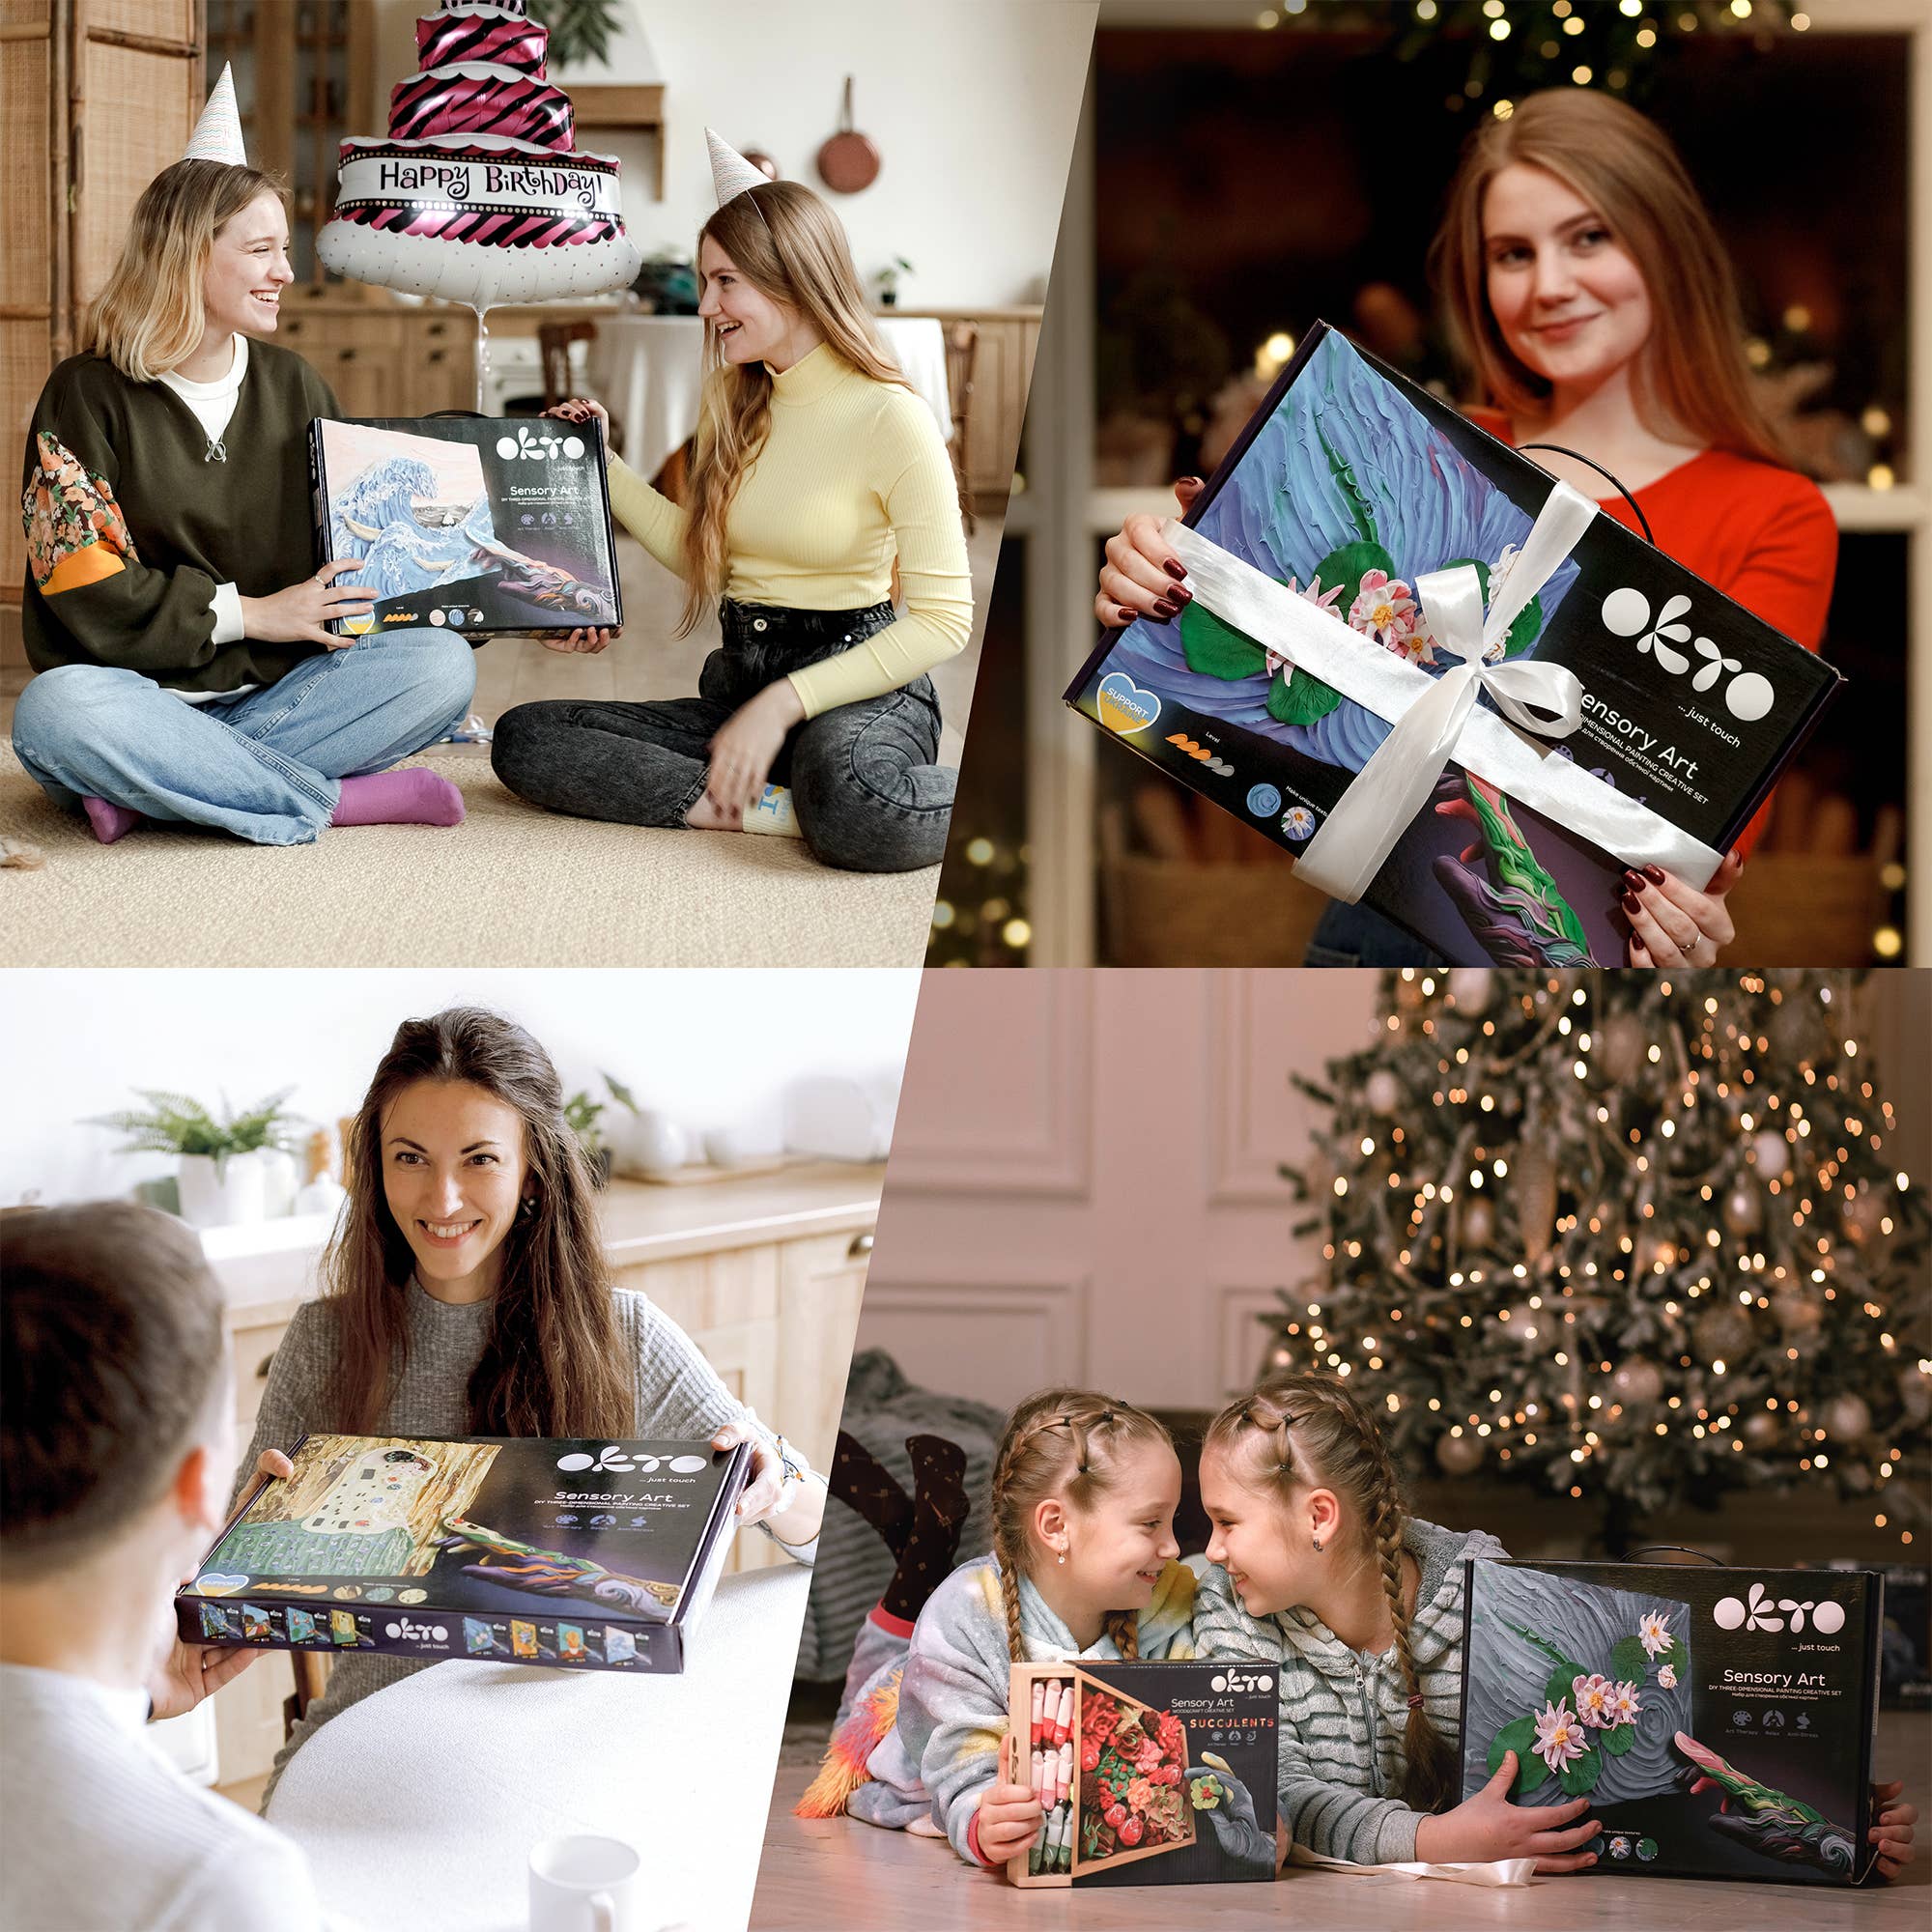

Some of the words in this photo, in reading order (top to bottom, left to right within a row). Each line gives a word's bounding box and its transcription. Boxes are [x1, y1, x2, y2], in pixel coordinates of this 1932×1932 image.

[381, 162, 470, 200] Happy
[510, 486, 557, 497] Sensory
[560, 486, 580, 496] Art
[1106, 687, 1149, 718] SUPPORT
[1206, 731, 1221, 744] Level
[1578, 684, 1658, 751] ensory
[1657, 746, 1698, 780] Art
[1710, 722, 1741, 749] touch
[1625, 745, 1660, 772] PAINTING
[1659, 768, 1693, 795] CREATIVE
[1692, 791, 1709, 805] SET
[1286, 785, 1299, 797] Make
[554, 1492, 635, 1501] Sensory
[639, 1493, 673, 1502] Art
[1723, 1669, 1792, 1687] Sensory
[1797, 1673, 1826, 1687] Art
[1171, 1698, 1214, 1709] Sensory
[1217, 1698, 1235, 1707] Art
[1190, 1718, 1274, 1728] SUCCULENTS
